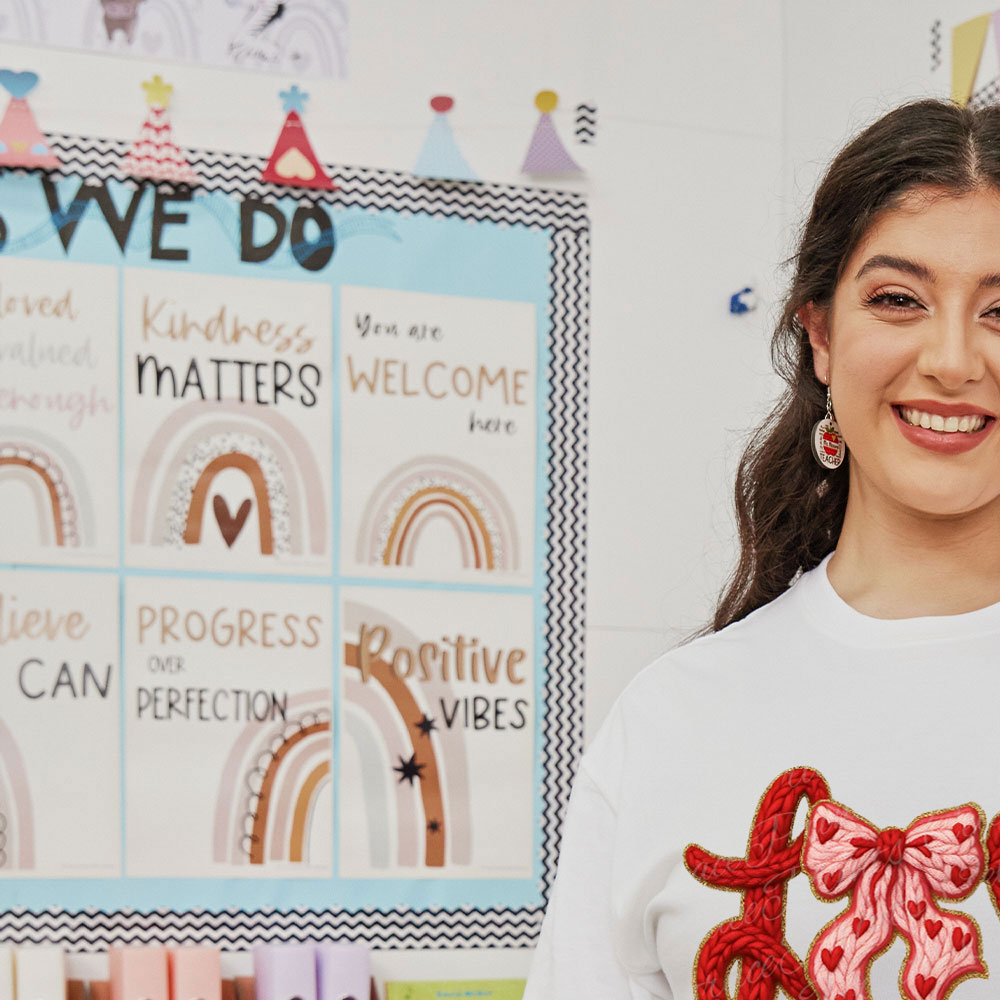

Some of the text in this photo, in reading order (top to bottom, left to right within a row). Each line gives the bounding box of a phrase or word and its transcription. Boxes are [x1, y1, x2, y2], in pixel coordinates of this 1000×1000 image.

[41, 172, 192, 261] WE
[240, 195, 336, 272] DO
[0, 287, 79, 321] oved
[142, 294, 319, 355] Kindness
[355, 312, 445, 341] You are
[347, 353, 530, 406] WELCOME
[468, 410, 518, 436] here
[137, 604, 322, 649] PROGRESS
[148, 654, 187, 674] OVER
[359, 622, 528, 686] Positive
[18, 657, 113, 700] CAN
[136, 686, 288, 722] PERFECTION
[439, 696, 529, 731] VIBES
